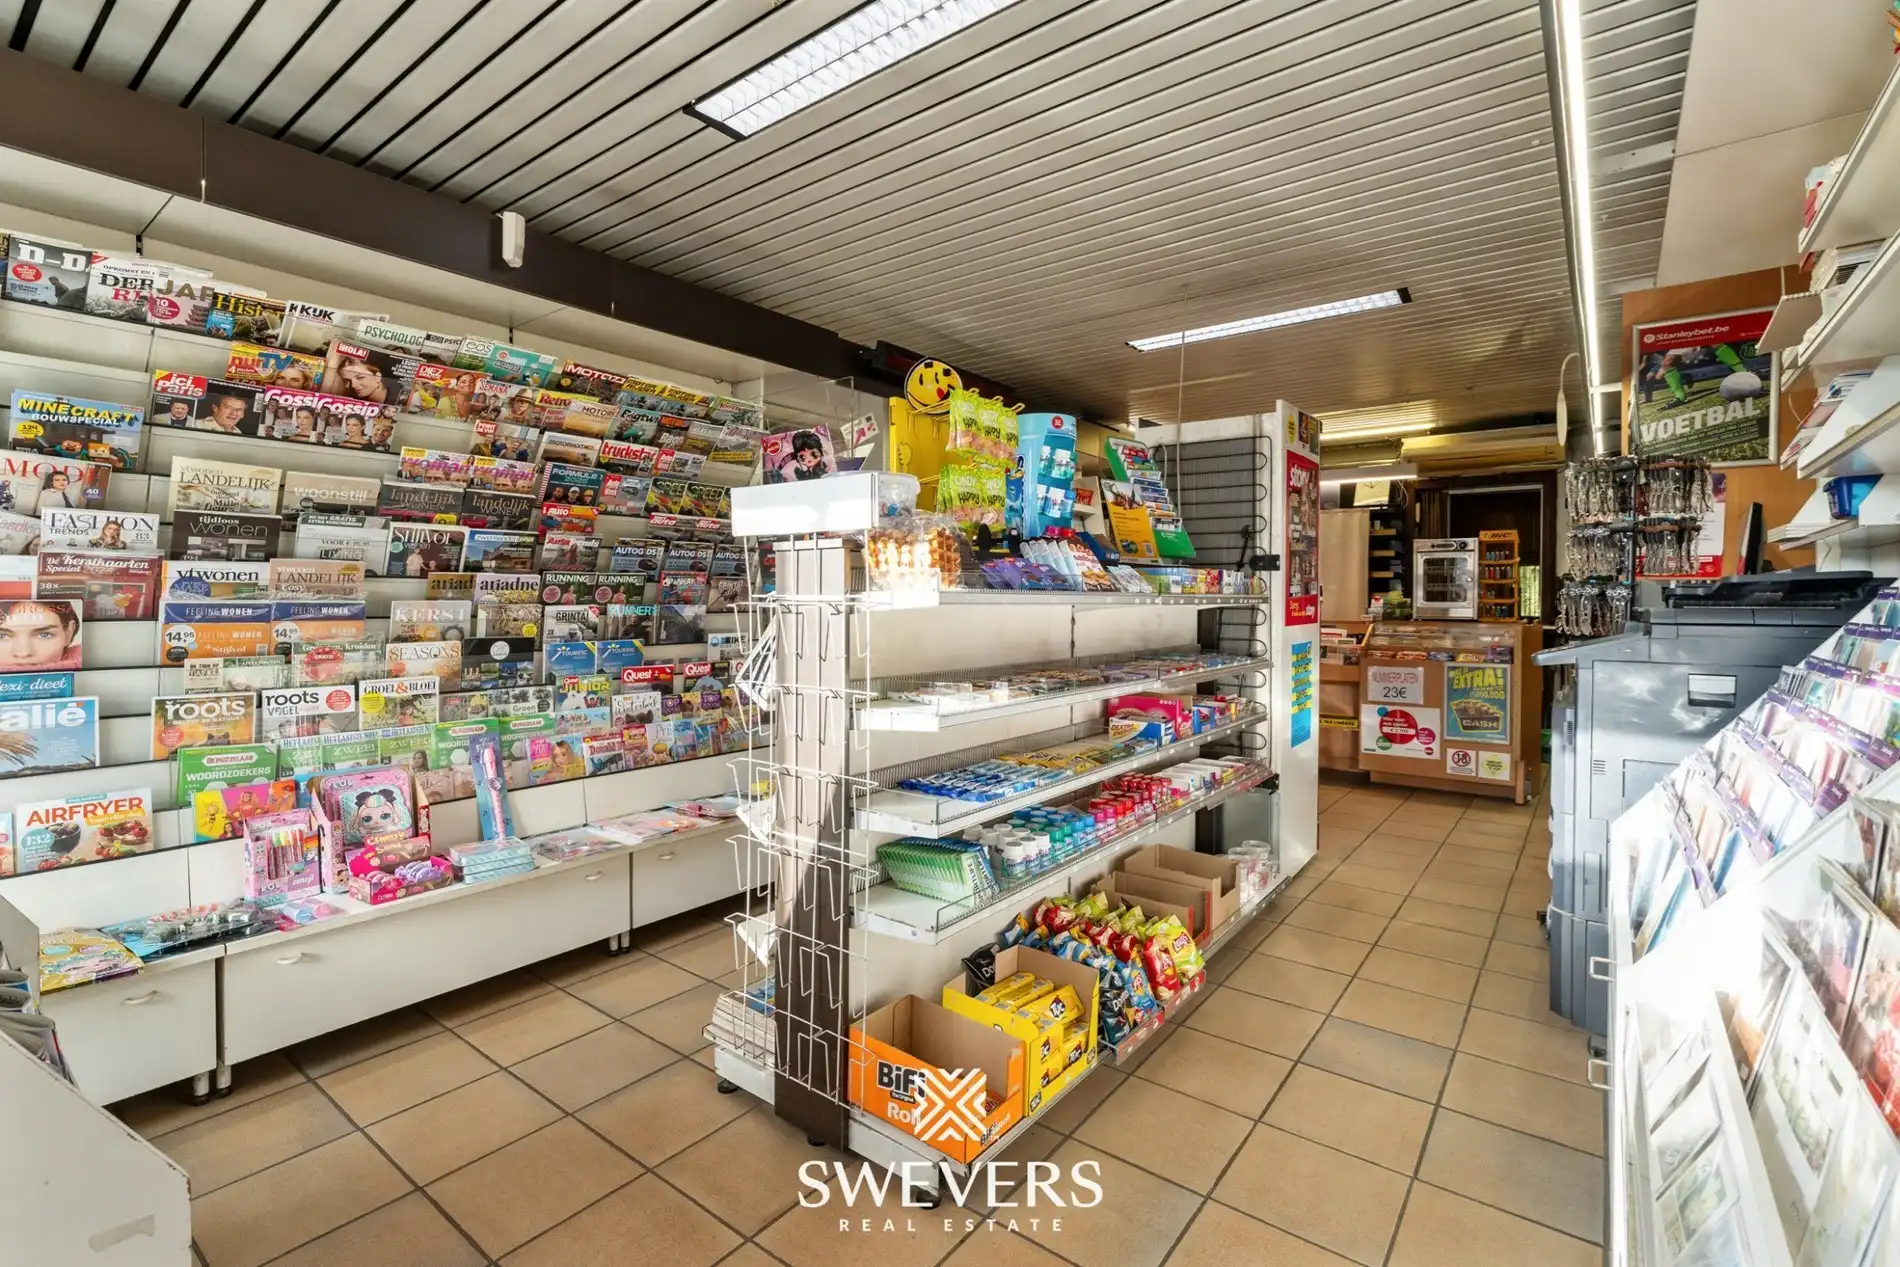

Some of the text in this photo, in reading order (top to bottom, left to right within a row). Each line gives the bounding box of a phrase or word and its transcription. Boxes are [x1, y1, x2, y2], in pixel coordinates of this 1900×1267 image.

[156, 297, 169, 307] 10
[364, 325, 426, 347] PSYCHOLOG
[1656, 326, 1730, 341] Stanleybet.be
[257, 351, 293, 370] TV
[420, 365, 444, 376] DIEZ
[169, 373, 193, 388] ici
[155, 380, 204, 397] Paris
[18, 398, 137, 424] MINECRAFT
[317, 395, 381, 418] Gossip
[30, 413, 120, 427] BOUWSPECIAL
[1640, 396, 1761, 443] VOETBAL
[179, 470, 270, 491] LANDELIJK
[295, 486, 367, 504] woonstijl
[958, 492, 980, 505] HAPPY
[49, 527, 89, 537] TRENDS
[190, 521, 269, 537] wonen
[45, 565, 83, 574] Special
[61, 554, 151, 570] Kerstkaarten
[176, 568, 260, 582] vtwonen
[276, 571, 357, 586] LANDELIJK
[546, 574, 589, 584] RUNNING
[600, 574, 639, 584] RUNNING
[480, 577, 539, 591] ariadne
[555, 611, 590, 622] GRINTA!
[623, 669, 652, 682] Quest
[685, 664, 712, 677] Quest
[1372, 672, 1419, 684] NUMMERPLATEN
[1453, 667, 1504, 690] EXTRA!
[364, 680, 437, 694] GROEI & BLOEI
[560, 681, 611, 693] JUNIOR
[1383, 686, 1408, 699] 23€
[265, 690, 321, 706] roots
[165, 699, 246, 721] roots
[1111, 723, 1135, 731] DEXTRO
[1463, 719, 1498, 729] CASH
[186, 766, 272, 782] WOORDZOEKERS
[26, 797, 144, 828] AIRFRYER
[1051, 1002, 1066, 1017] TUC
[877, 1059, 927, 1099] BiFi
